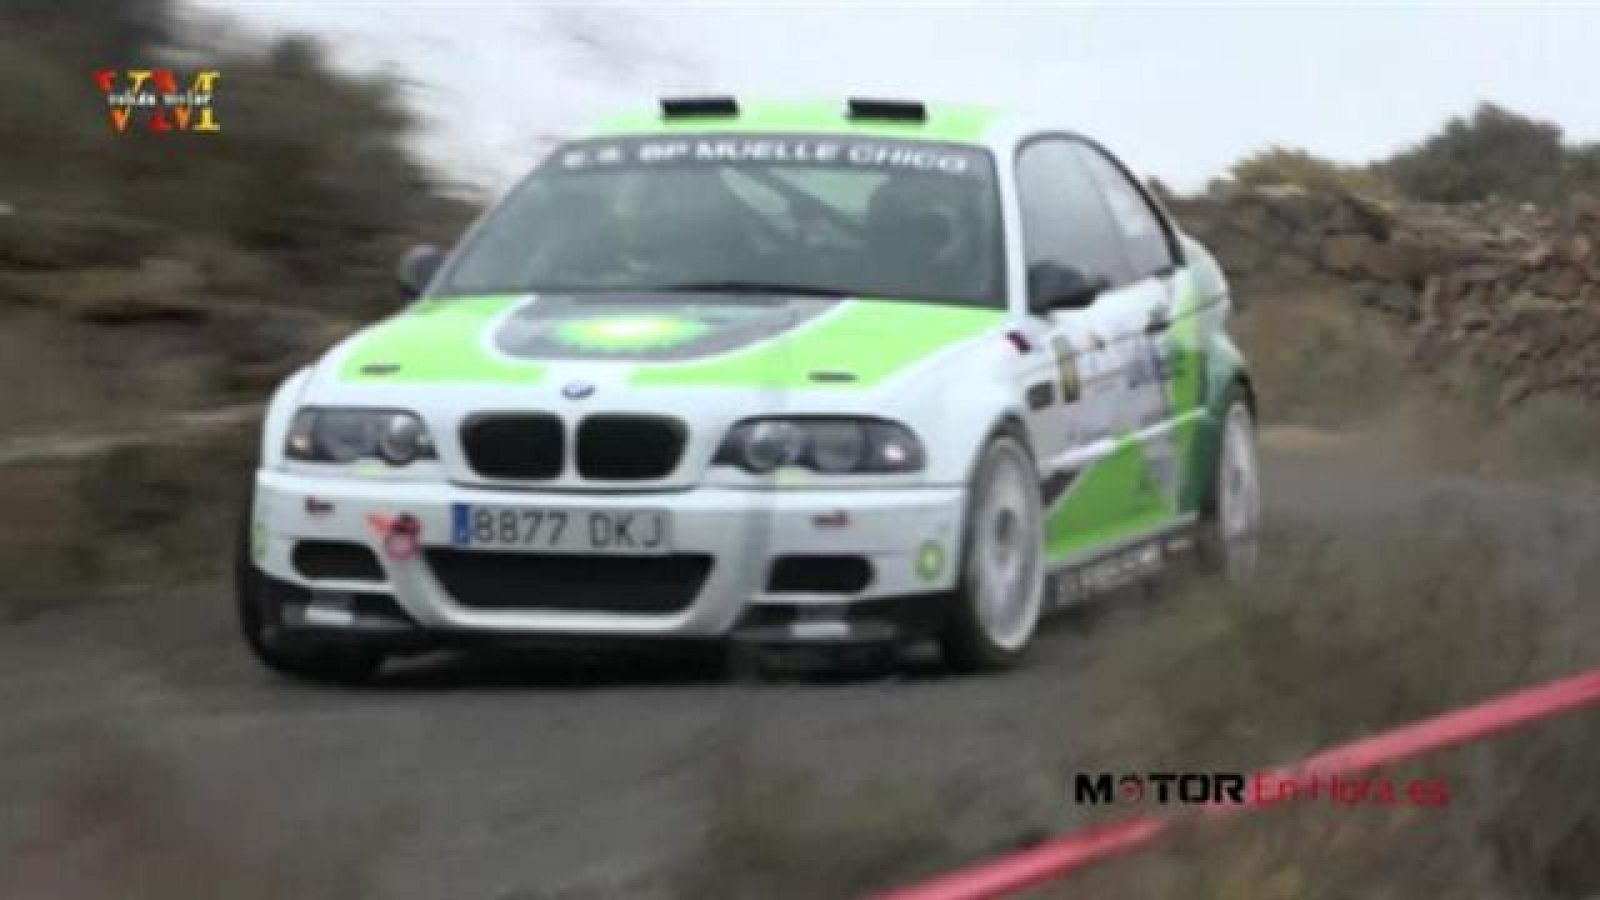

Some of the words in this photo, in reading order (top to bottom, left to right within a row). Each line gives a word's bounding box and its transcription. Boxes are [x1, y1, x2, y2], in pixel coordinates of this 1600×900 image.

[696, 141, 841, 162] MUELLE
[474, 509, 569, 545] 8877
[590, 511, 662, 547] DKJ
